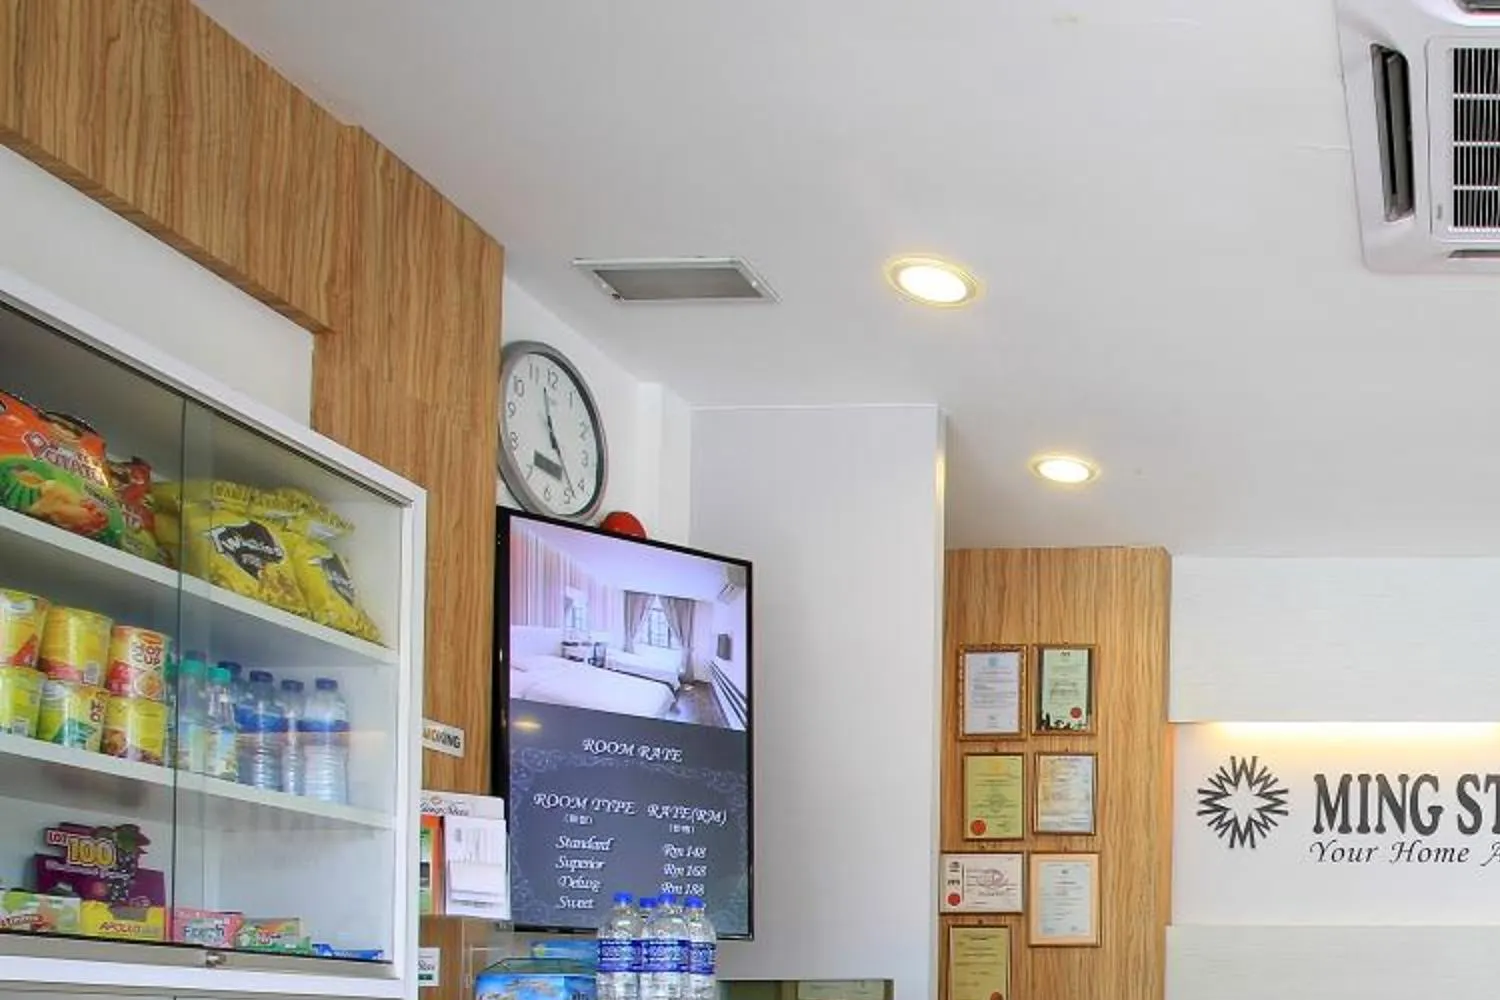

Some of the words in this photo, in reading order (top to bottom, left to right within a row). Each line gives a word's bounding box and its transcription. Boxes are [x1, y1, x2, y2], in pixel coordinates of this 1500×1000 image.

[547, 368, 559, 388] 12
[583, 738, 635, 756] ROOM
[637, 745, 683, 763] RATE
[533, 793, 588, 810] ROOM
[591, 798, 637, 815] TYPE
[1313, 773, 1444, 837] MING
[555, 836, 615, 851] Standard
[1309, 840, 1379, 863] Your
[1389, 840, 1470, 863] Home
[555, 855, 606, 873] Superior
